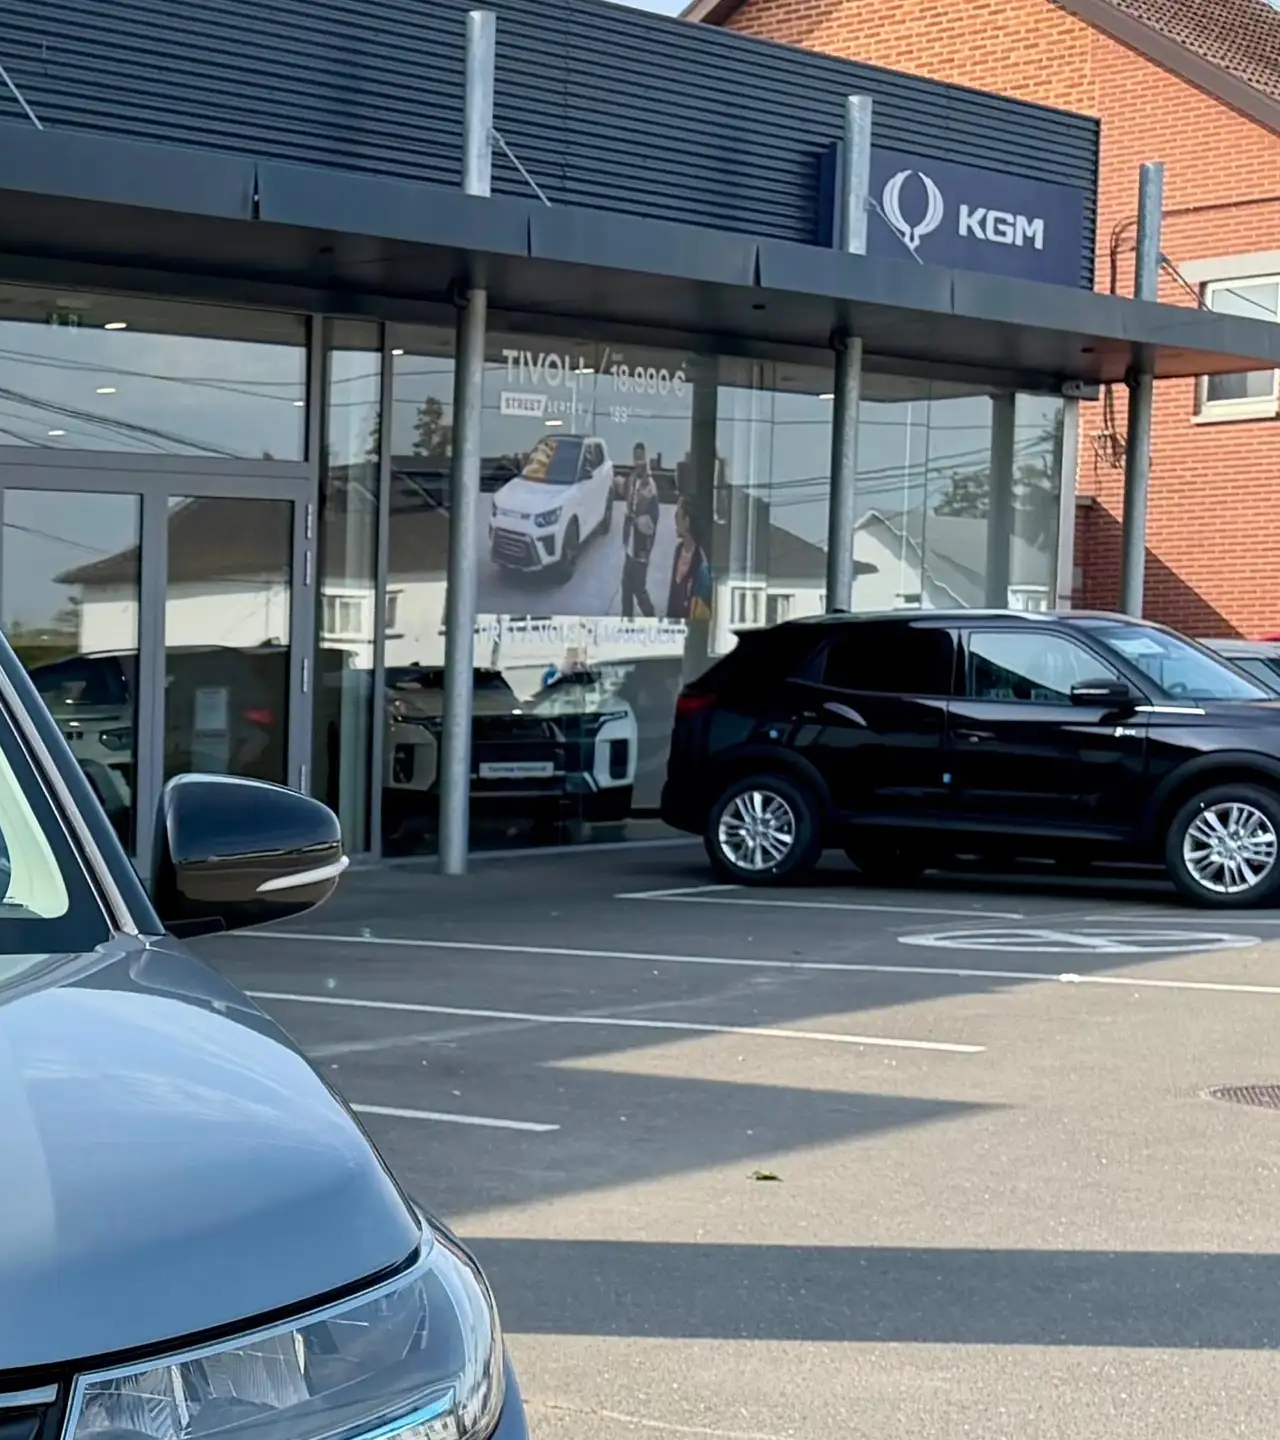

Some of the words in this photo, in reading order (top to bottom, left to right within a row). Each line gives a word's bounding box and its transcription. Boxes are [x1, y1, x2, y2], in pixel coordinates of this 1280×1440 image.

[958, 203, 1045, 250] KGM
[502, 348, 584, 389] TIVOLI
[504, 396, 543, 413] STREET
